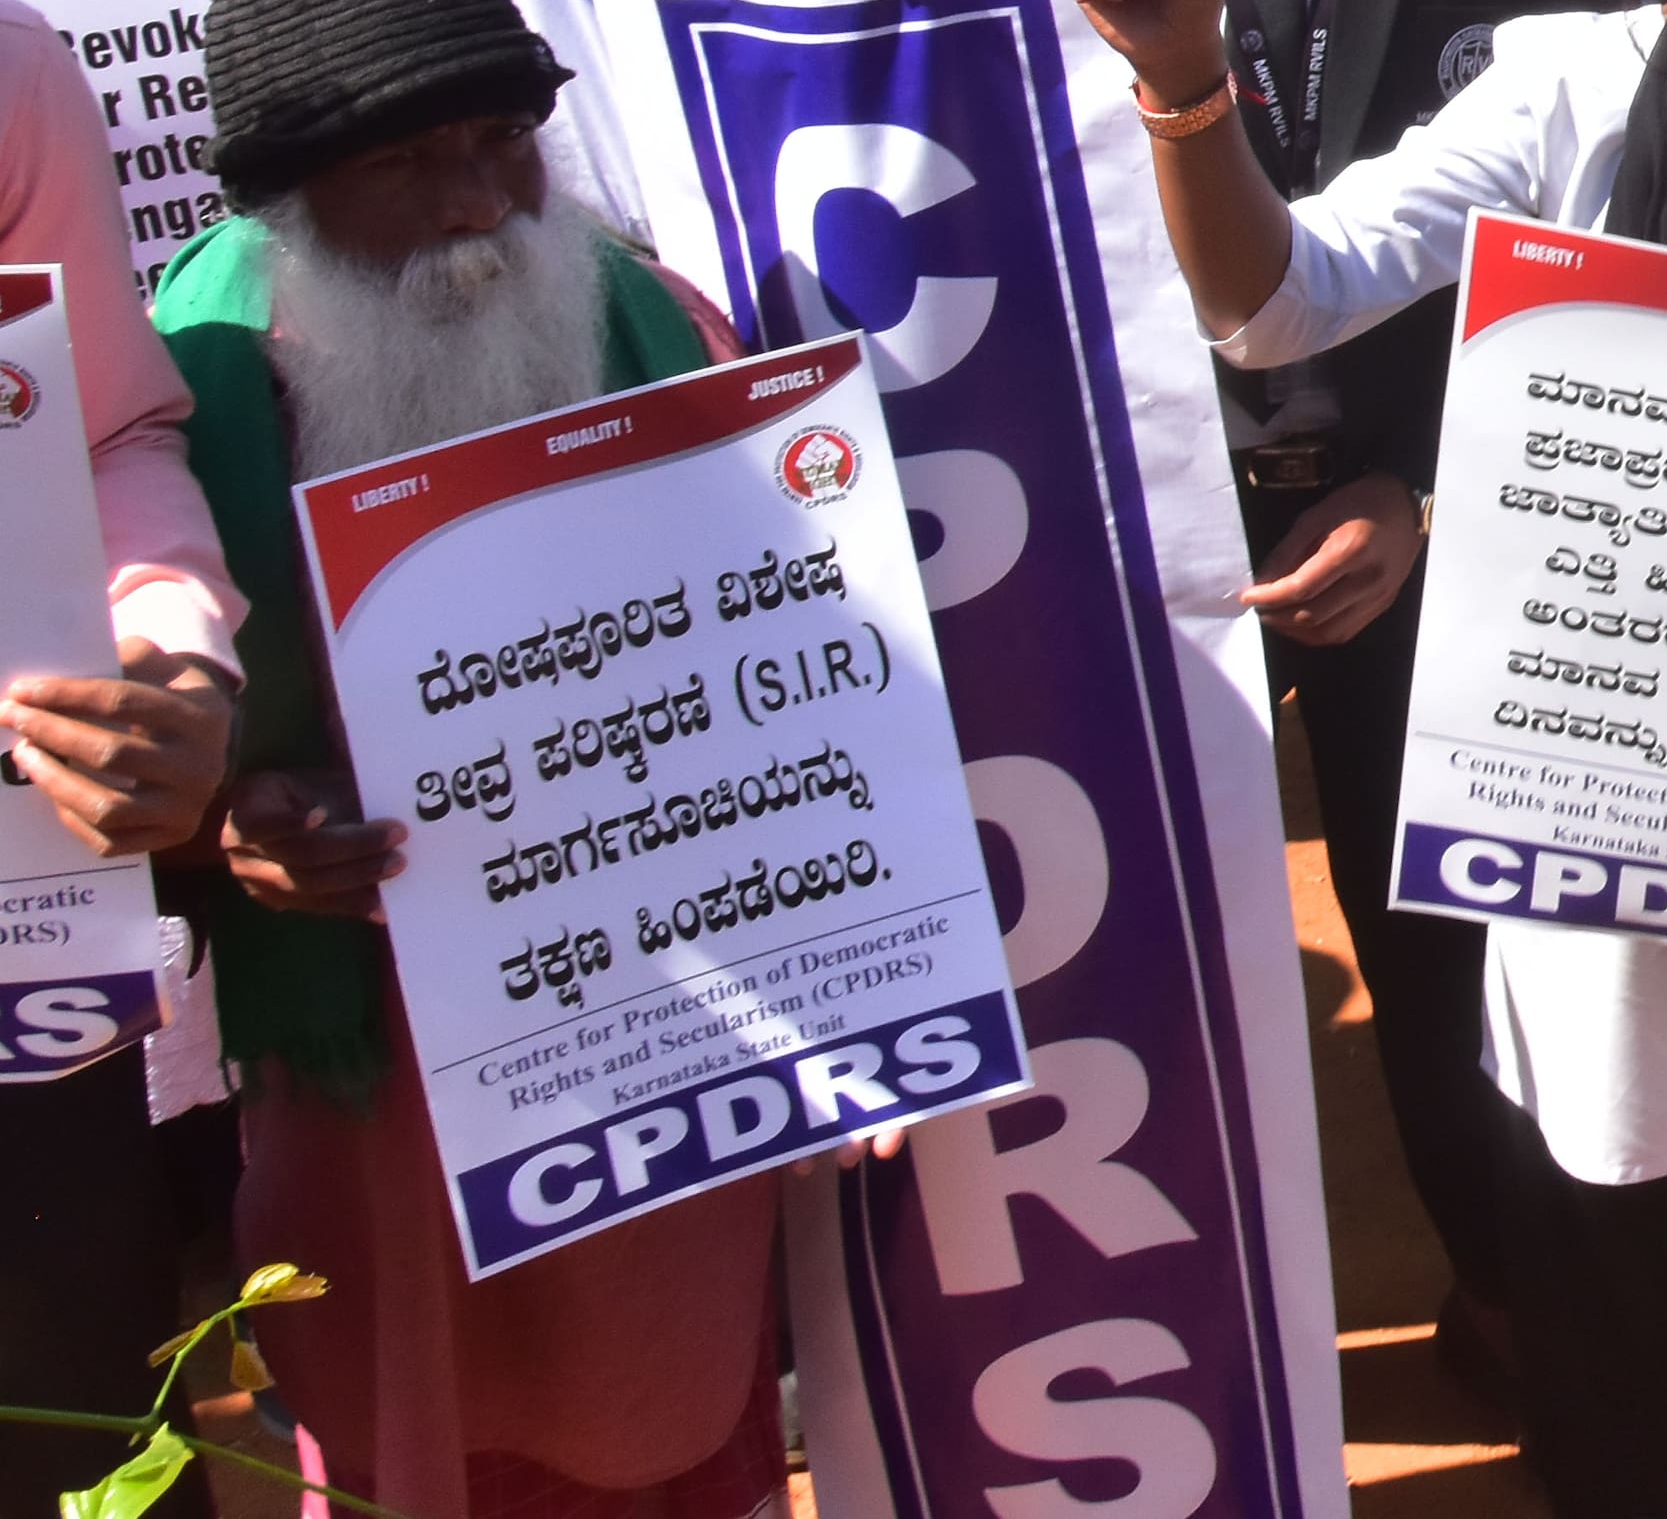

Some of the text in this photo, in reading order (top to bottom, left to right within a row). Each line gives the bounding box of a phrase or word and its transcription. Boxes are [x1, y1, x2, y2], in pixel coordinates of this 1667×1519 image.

[418, 536, 846, 715] ದೋಷಪೂರಿತ ವಿಶೇಷ
[1507, 647, 1660, 698] ಮಾನವ
[415, 622, 892, 823] ತೀವ್ರ ಪರಿಷ್ಕರಣೆ (S.I.R.)
[1493, 699, 1667, 768] ದಿನವನ್ನು
[1448, 748, 1534, 781] Centre
[1539, 764, 1575, 790] for
[1468, 780, 1546, 819] Rights
[1552, 795, 1597, 821] and
[482, 738, 875, 905] ಮಾರ್ಗಸೂಚಿಯನ್ನು
[1553, 826, 1660, 858] Karnataka
[0, 884, 95, 913] cratic
[477, 914, 951, 1087] Centre for Protection of Democratic
[500, 924, 611, 1009] ತಕ್ಷಣ
[509, 951, 934, 1113] Rights and Secularism (CPDRS)
[611, 1013, 847, 1105] Karnataka State Unit
[508, 1015, 983, 1228] CPDRS
